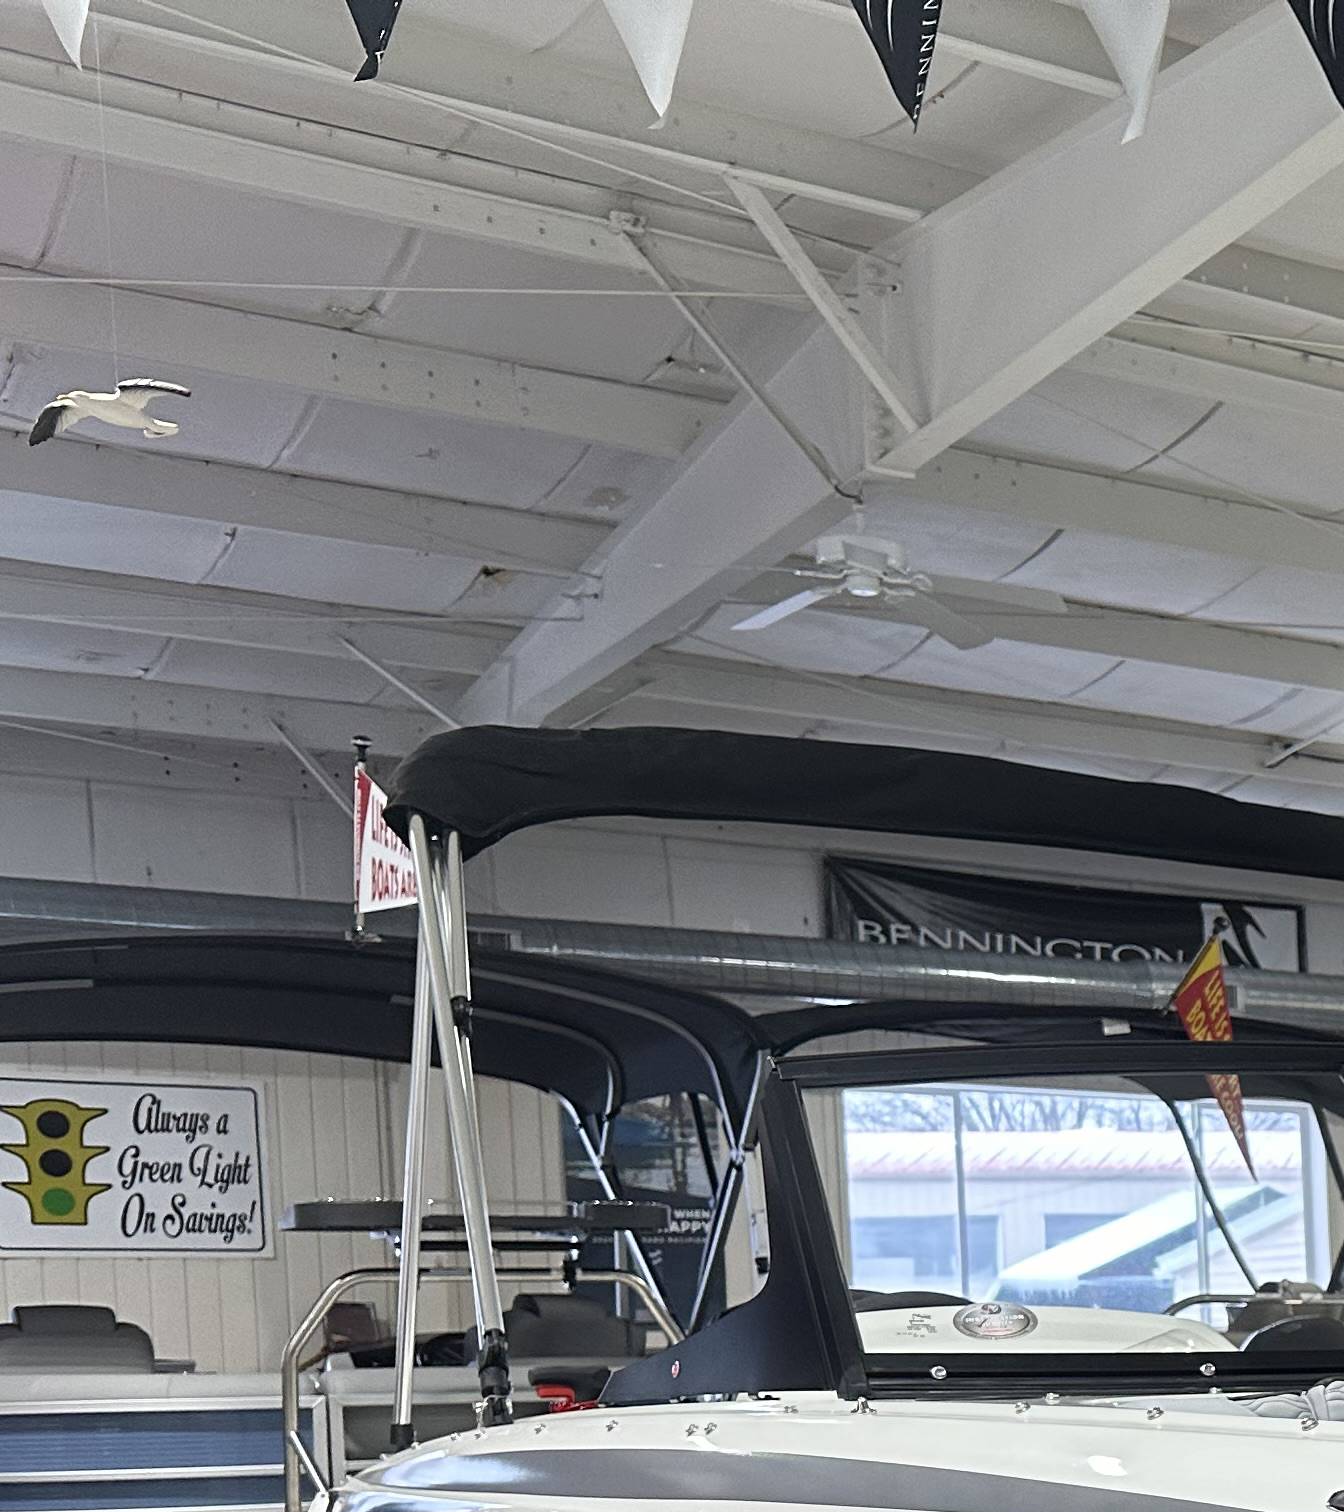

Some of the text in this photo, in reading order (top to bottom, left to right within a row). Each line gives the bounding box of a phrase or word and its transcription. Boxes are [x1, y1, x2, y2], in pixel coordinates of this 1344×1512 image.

[132, 1093, 229, 1143] Always a
[117, 1143, 252, 1194] Green Light
[121, 1193, 257, 1244] On Savings!
[657, 1221, 710, 1233] APPY
